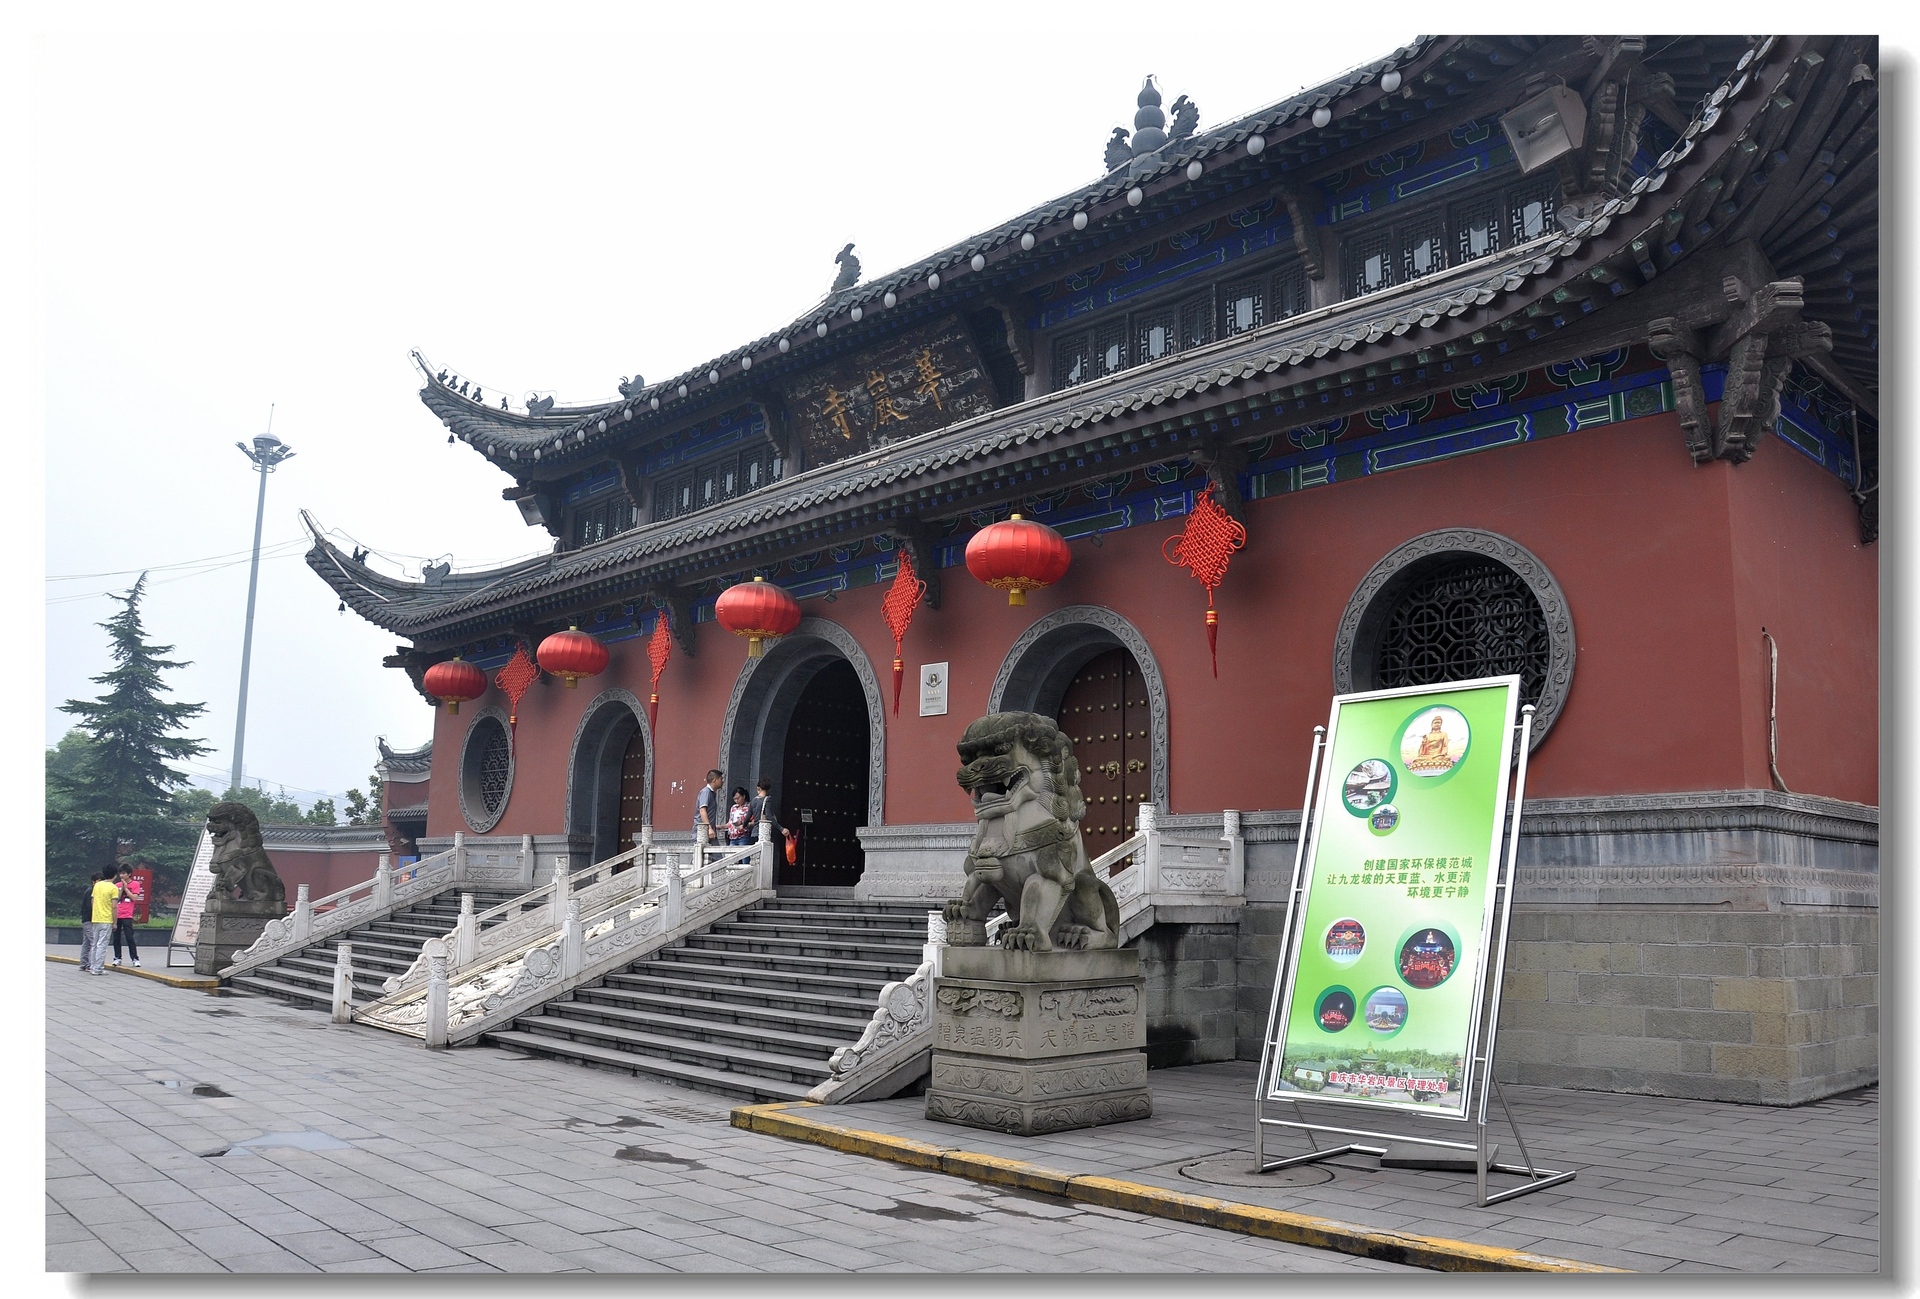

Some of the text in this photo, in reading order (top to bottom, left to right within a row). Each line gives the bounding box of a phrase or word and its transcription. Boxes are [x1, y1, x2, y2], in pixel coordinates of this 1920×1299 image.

[1363, 856, 1473, 871] 创建国家环保模范城
[1327, 871, 1471, 885] 让九龙坡的天更蓝、水更清
[1406, 886, 1470, 898] 环境更宁静
[1329, 1071, 1449, 1093] 重庆市华岩风景区管理处制
